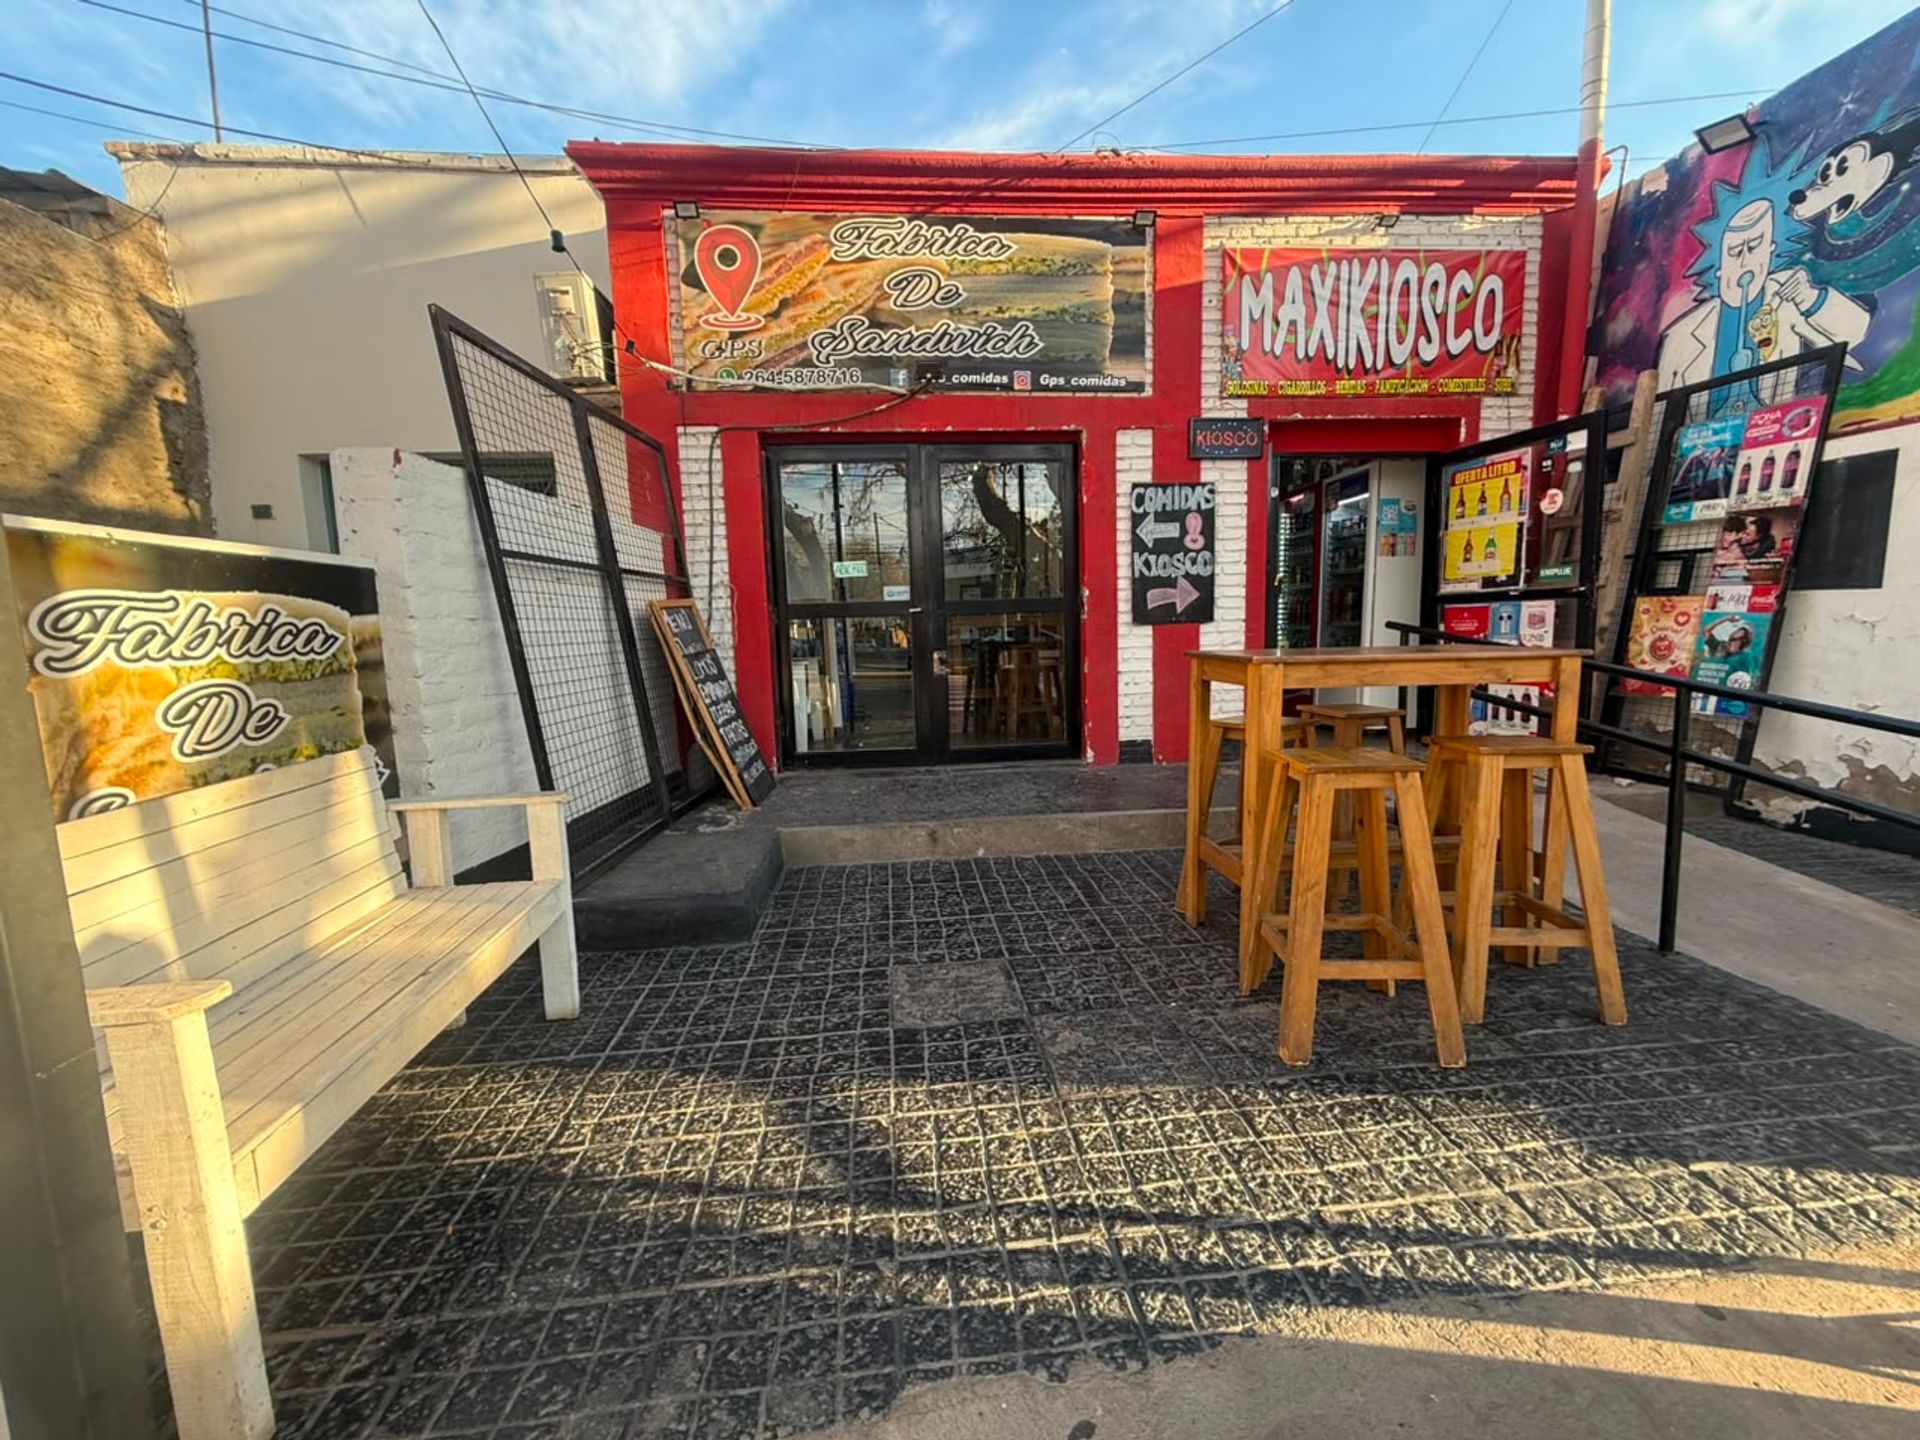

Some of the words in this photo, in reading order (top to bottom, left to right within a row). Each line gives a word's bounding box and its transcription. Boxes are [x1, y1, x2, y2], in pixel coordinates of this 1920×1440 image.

[830, 217, 1018, 260] Fabrica
[884, 267, 968, 310] De
[1239, 257, 1505, 372] MAXIKIOSCO
[700, 339, 765, 361] GPS
[809, 315, 1044, 367] Sandwich
[1040, 374, 1127, 388] Gps_comidas
[1196, 430, 1258, 447] KIOSCO
[1455, 466, 1487, 485] OFERTA
[1488, 460, 1517, 479] LITRO
[1132, 484, 1215, 513] COMIDAS
[1133, 551, 1214, 578] KIOSCO
[27, 588, 345, 680] Fabrica
[155, 678, 292, 763] De
